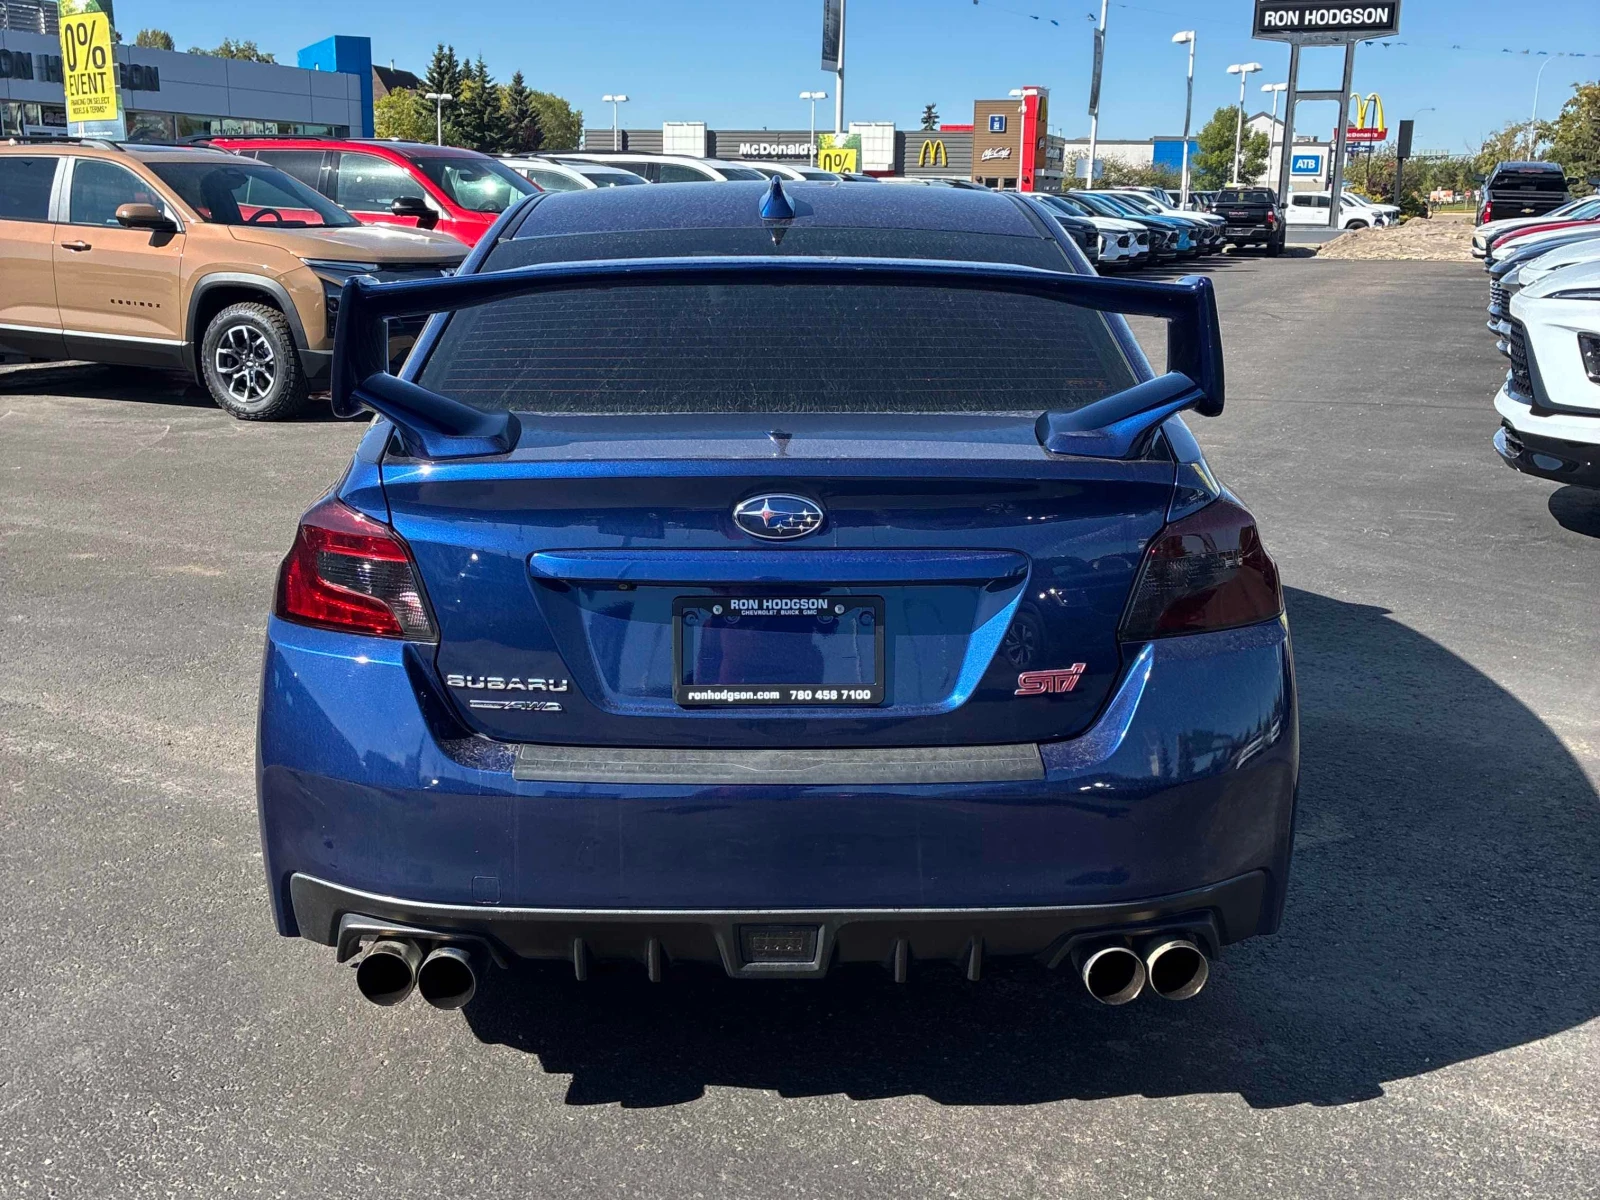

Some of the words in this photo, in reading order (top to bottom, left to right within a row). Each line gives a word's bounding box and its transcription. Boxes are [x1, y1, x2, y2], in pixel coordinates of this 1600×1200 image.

[1264, 10, 1299, 27] RON
[1304, 8, 1389, 25] HODGSON
[65, 20, 106, 72] 0%
[0, 48, 33, 80] ON
[69, 72, 106, 96] EVENT
[93, 96, 110, 105] SELECT
[739, 143, 818, 155] McDonald's
[1295, 159, 1316, 169] ATB
[110, 298, 161, 309] EQUINOX
[730, 599, 759, 610] RON
[763, 599, 828, 610] HODGSON
[446, 674, 568, 692] SUBARU
[688, 689, 780, 702] ronhodgson.com
[790, 690, 812, 700] 780
[814, 690, 838, 700] 458
[841, 690, 871, 700] 7100
